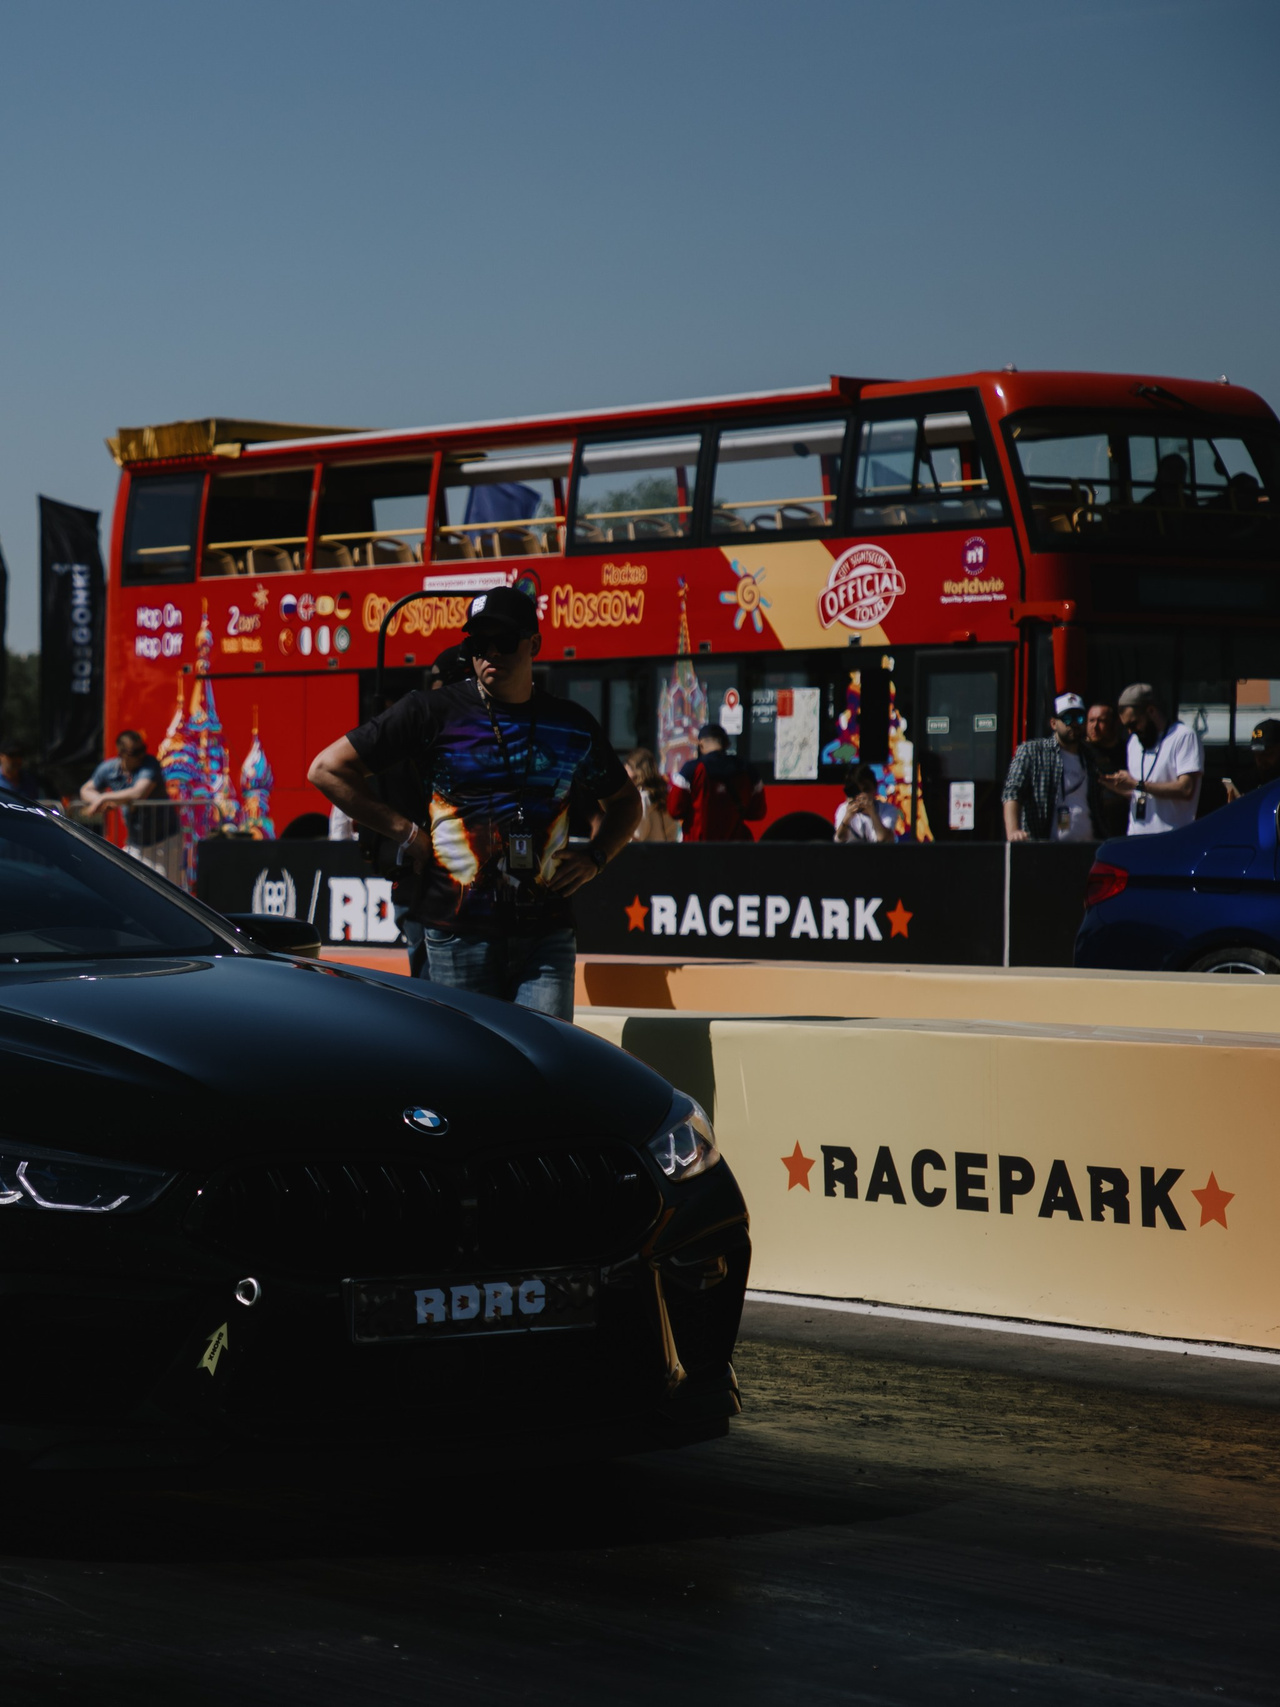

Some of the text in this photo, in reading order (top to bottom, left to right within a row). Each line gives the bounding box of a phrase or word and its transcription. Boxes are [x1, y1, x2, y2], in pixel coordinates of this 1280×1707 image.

[824, 572, 901, 618] OFFICIAL
[854, 598, 888, 621] TOUR
[136, 602, 182, 631] Hop On
[227, 605, 240, 636] 2
[135, 631, 183, 660] Hop Off
[649, 893, 884, 942] RACEPARK
[820, 1144, 1188, 1232] RACEPARK
[413, 1279, 547, 1325] RDRC
